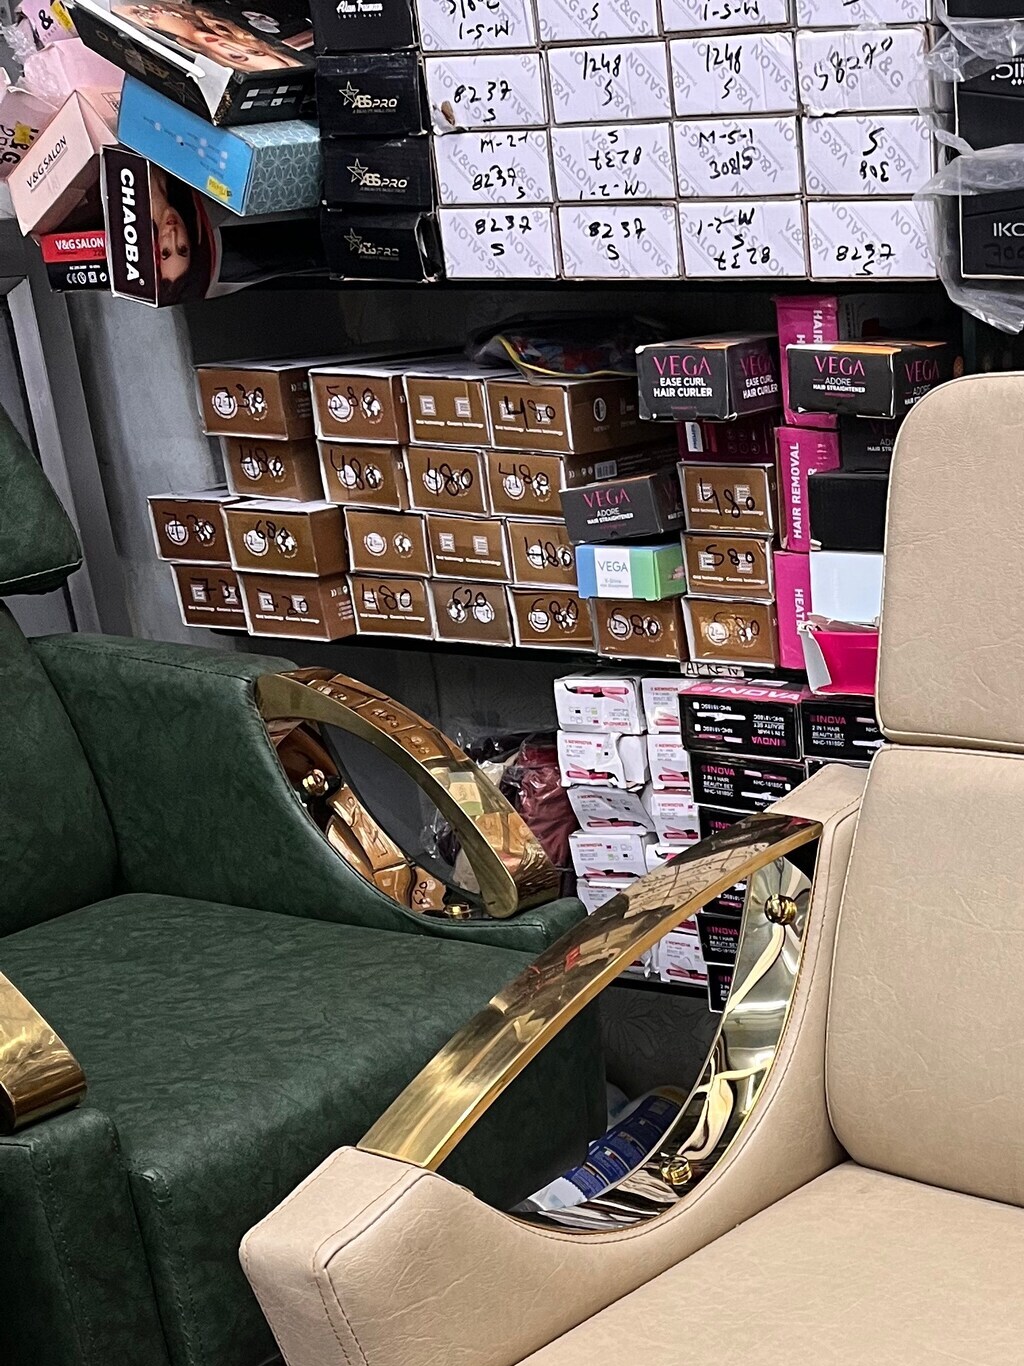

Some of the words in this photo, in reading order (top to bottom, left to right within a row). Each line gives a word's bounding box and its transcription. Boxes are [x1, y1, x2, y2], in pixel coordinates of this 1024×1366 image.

[583, 50, 622, 81] 1248
[706, 43, 742, 75] 1248
[453, 80, 513, 104] 8237
[43, 135, 67, 172] SALON
[119, 168, 141, 282] CHAOBA
[475, 215, 532, 235] 8237
[588, 217, 646, 239] 8237
[55, 238, 76, 250] V&G
[75, 237, 104, 249] SALON
[490, 243, 505, 256] S
[606, 244, 620, 260] S
[835, 243, 897, 262] 8237
[653, 355, 712, 376] VEGA
[814, 355, 866, 377] VEGA
[904, 359, 940, 383] VEGA
[660, 377, 682, 387] EASE
[684, 377, 706, 387] CURL
[824, 376, 852, 386] ADORE
[653, 388, 675, 398] HAIR
[677, 387, 713, 397] CURLER
[742, 388, 757, 400] HAIR
[790, 442, 801, 503] REMOVAL
[583, 487, 631, 508] VEGA
[700, 478, 756, 518] 480
[597, 506, 620, 518] ADORE
[793, 511, 803, 539] HAIR
[597, 560, 628, 572] VEGA
[815, 715, 847, 725] INOVA
[751, 736, 781, 747] INOVA
[706, 765, 736, 776] INOVA
